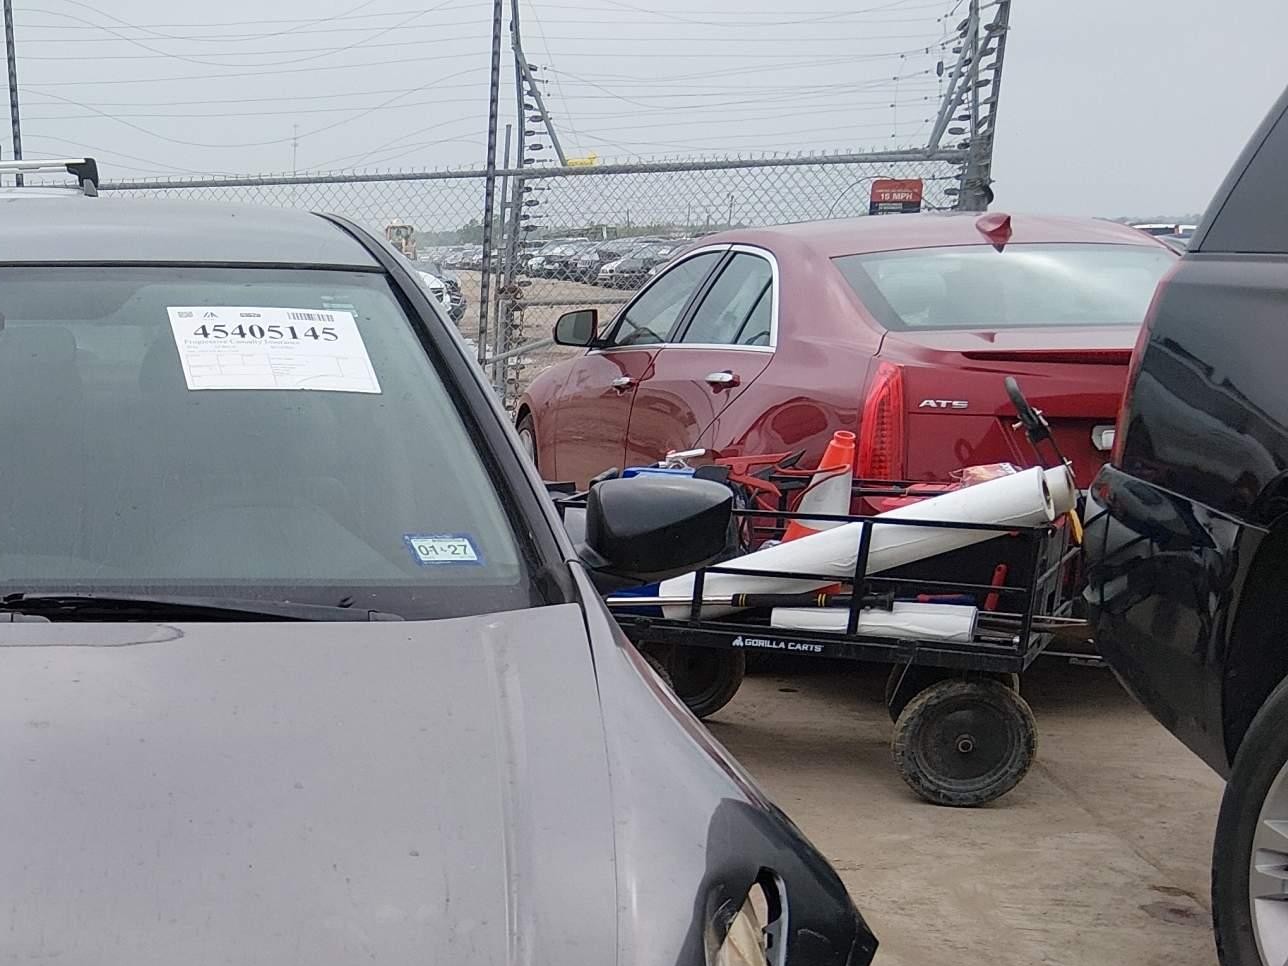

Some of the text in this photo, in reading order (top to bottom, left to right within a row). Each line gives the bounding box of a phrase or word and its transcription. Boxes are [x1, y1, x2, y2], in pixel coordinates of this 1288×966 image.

[193, 324, 339, 342] 45405145
[919, 399, 968, 409] ATS
[418, 544, 467, 556] 01-27
[745, 638, 823, 653] GORILLA CARTS
